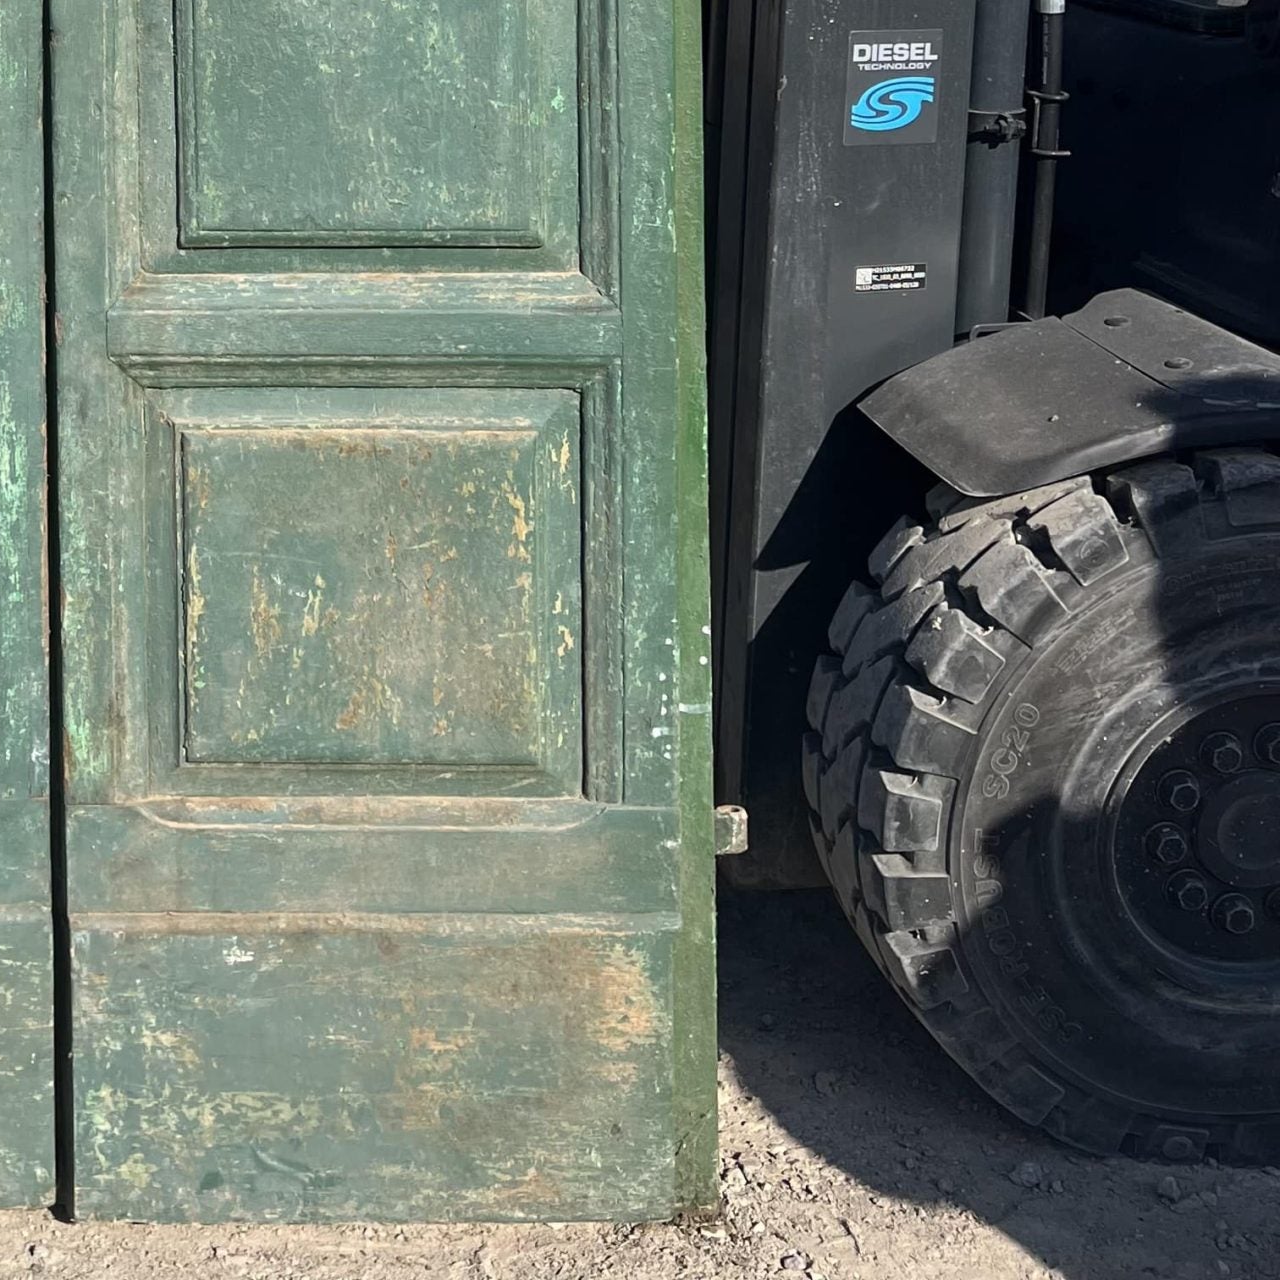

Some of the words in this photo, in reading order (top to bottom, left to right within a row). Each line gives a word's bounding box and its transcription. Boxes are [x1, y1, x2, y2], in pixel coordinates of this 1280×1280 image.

[853, 42, 939, 62] DIESEL
[857, 61, 933, 72] TECHNOLOGY
[982, 702, 1041, 801] SC20
